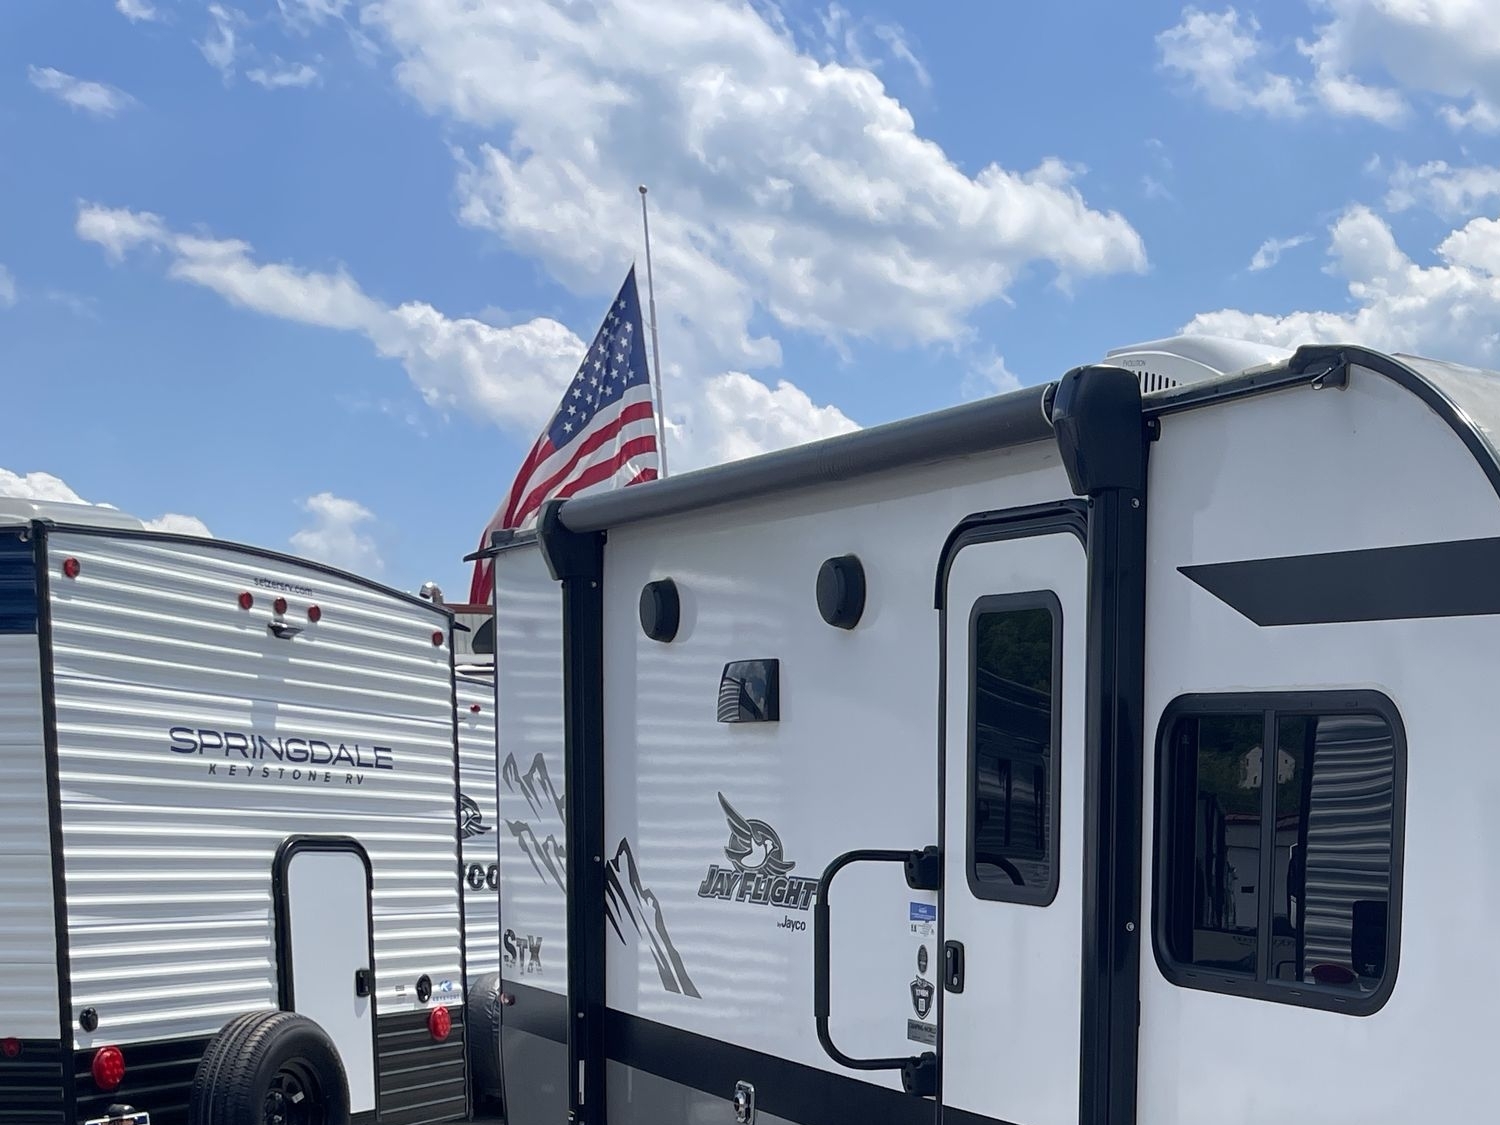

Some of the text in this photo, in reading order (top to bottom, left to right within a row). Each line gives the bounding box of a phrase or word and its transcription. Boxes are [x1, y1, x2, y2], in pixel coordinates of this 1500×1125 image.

[169, 727, 394, 770] SPRINGDALE
[208, 763, 364, 785] KEYSTONE RV
[698, 865, 819, 911] JAY FLIGHT
[782, 915, 807, 932] Jayco
[503, 929, 543, 975] STX
